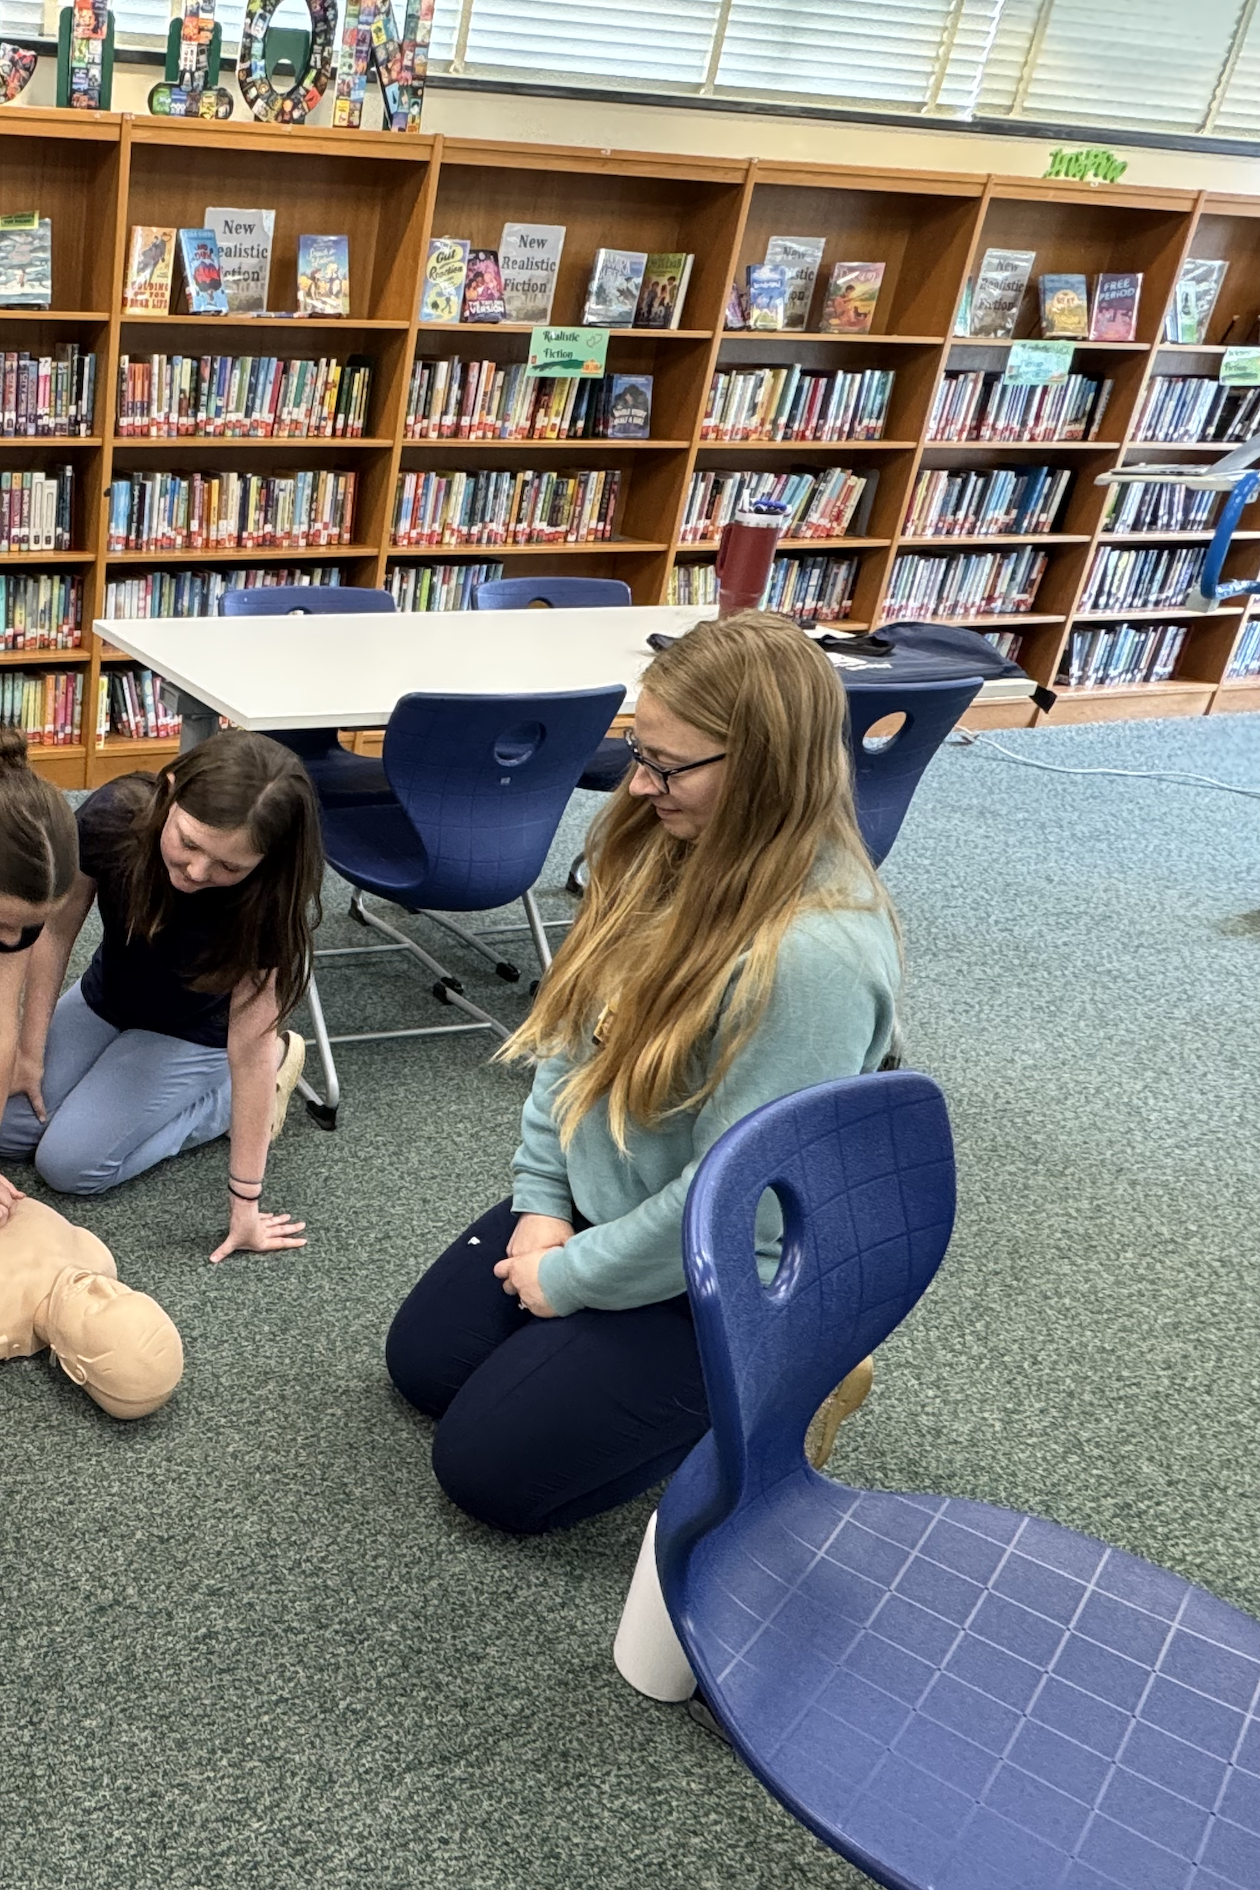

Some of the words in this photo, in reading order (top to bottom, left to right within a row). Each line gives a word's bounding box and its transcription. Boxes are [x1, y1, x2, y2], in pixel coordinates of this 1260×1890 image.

[222, 219, 256, 235] New
[517, 234, 549, 249] New
[217, 243, 268, 259] ealistic
[782, 246, 807, 260] New
[501, 255, 557, 273] Realistic
[996, 259, 1020, 272] New
[221, 265, 260, 282] iction
[502, 277, 548, 294] Fiction
[1103, 277, 1131, 292] FREE
[1099, 287, 1136, 301] PERIOD
[542, 330, 581, 342] Realistic
[543, 348, 574, 359] Fiction
